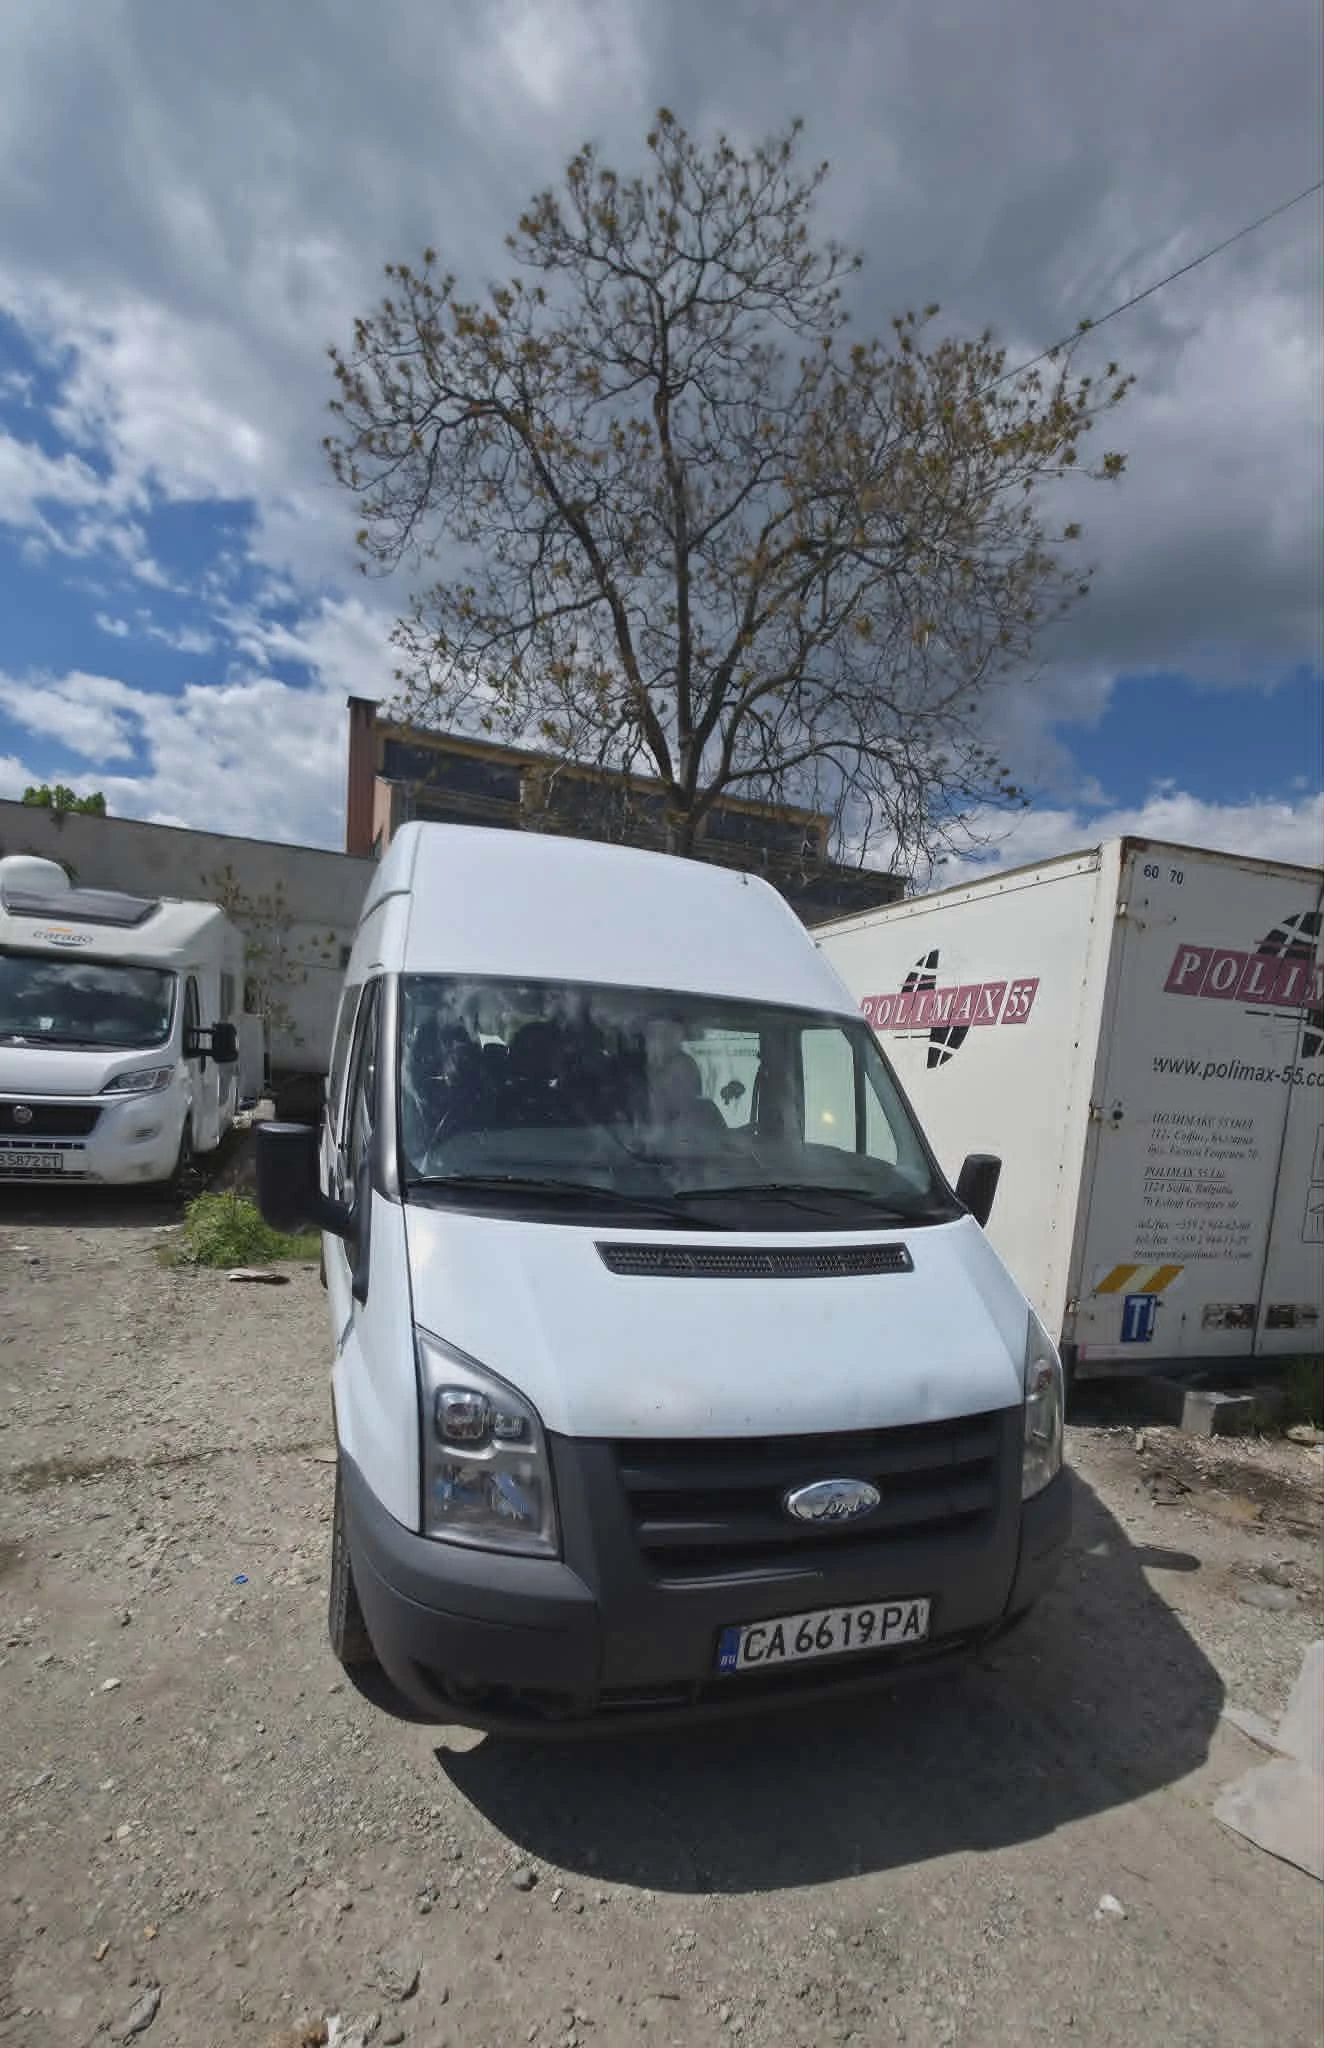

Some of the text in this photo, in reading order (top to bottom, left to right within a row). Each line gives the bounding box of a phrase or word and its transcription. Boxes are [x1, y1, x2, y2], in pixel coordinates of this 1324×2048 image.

[1143, 864, 1184, 885] 60 70
[33, 930, 94, 945] carado
[862, 985, 1033, 1026] POLIMAX 55
